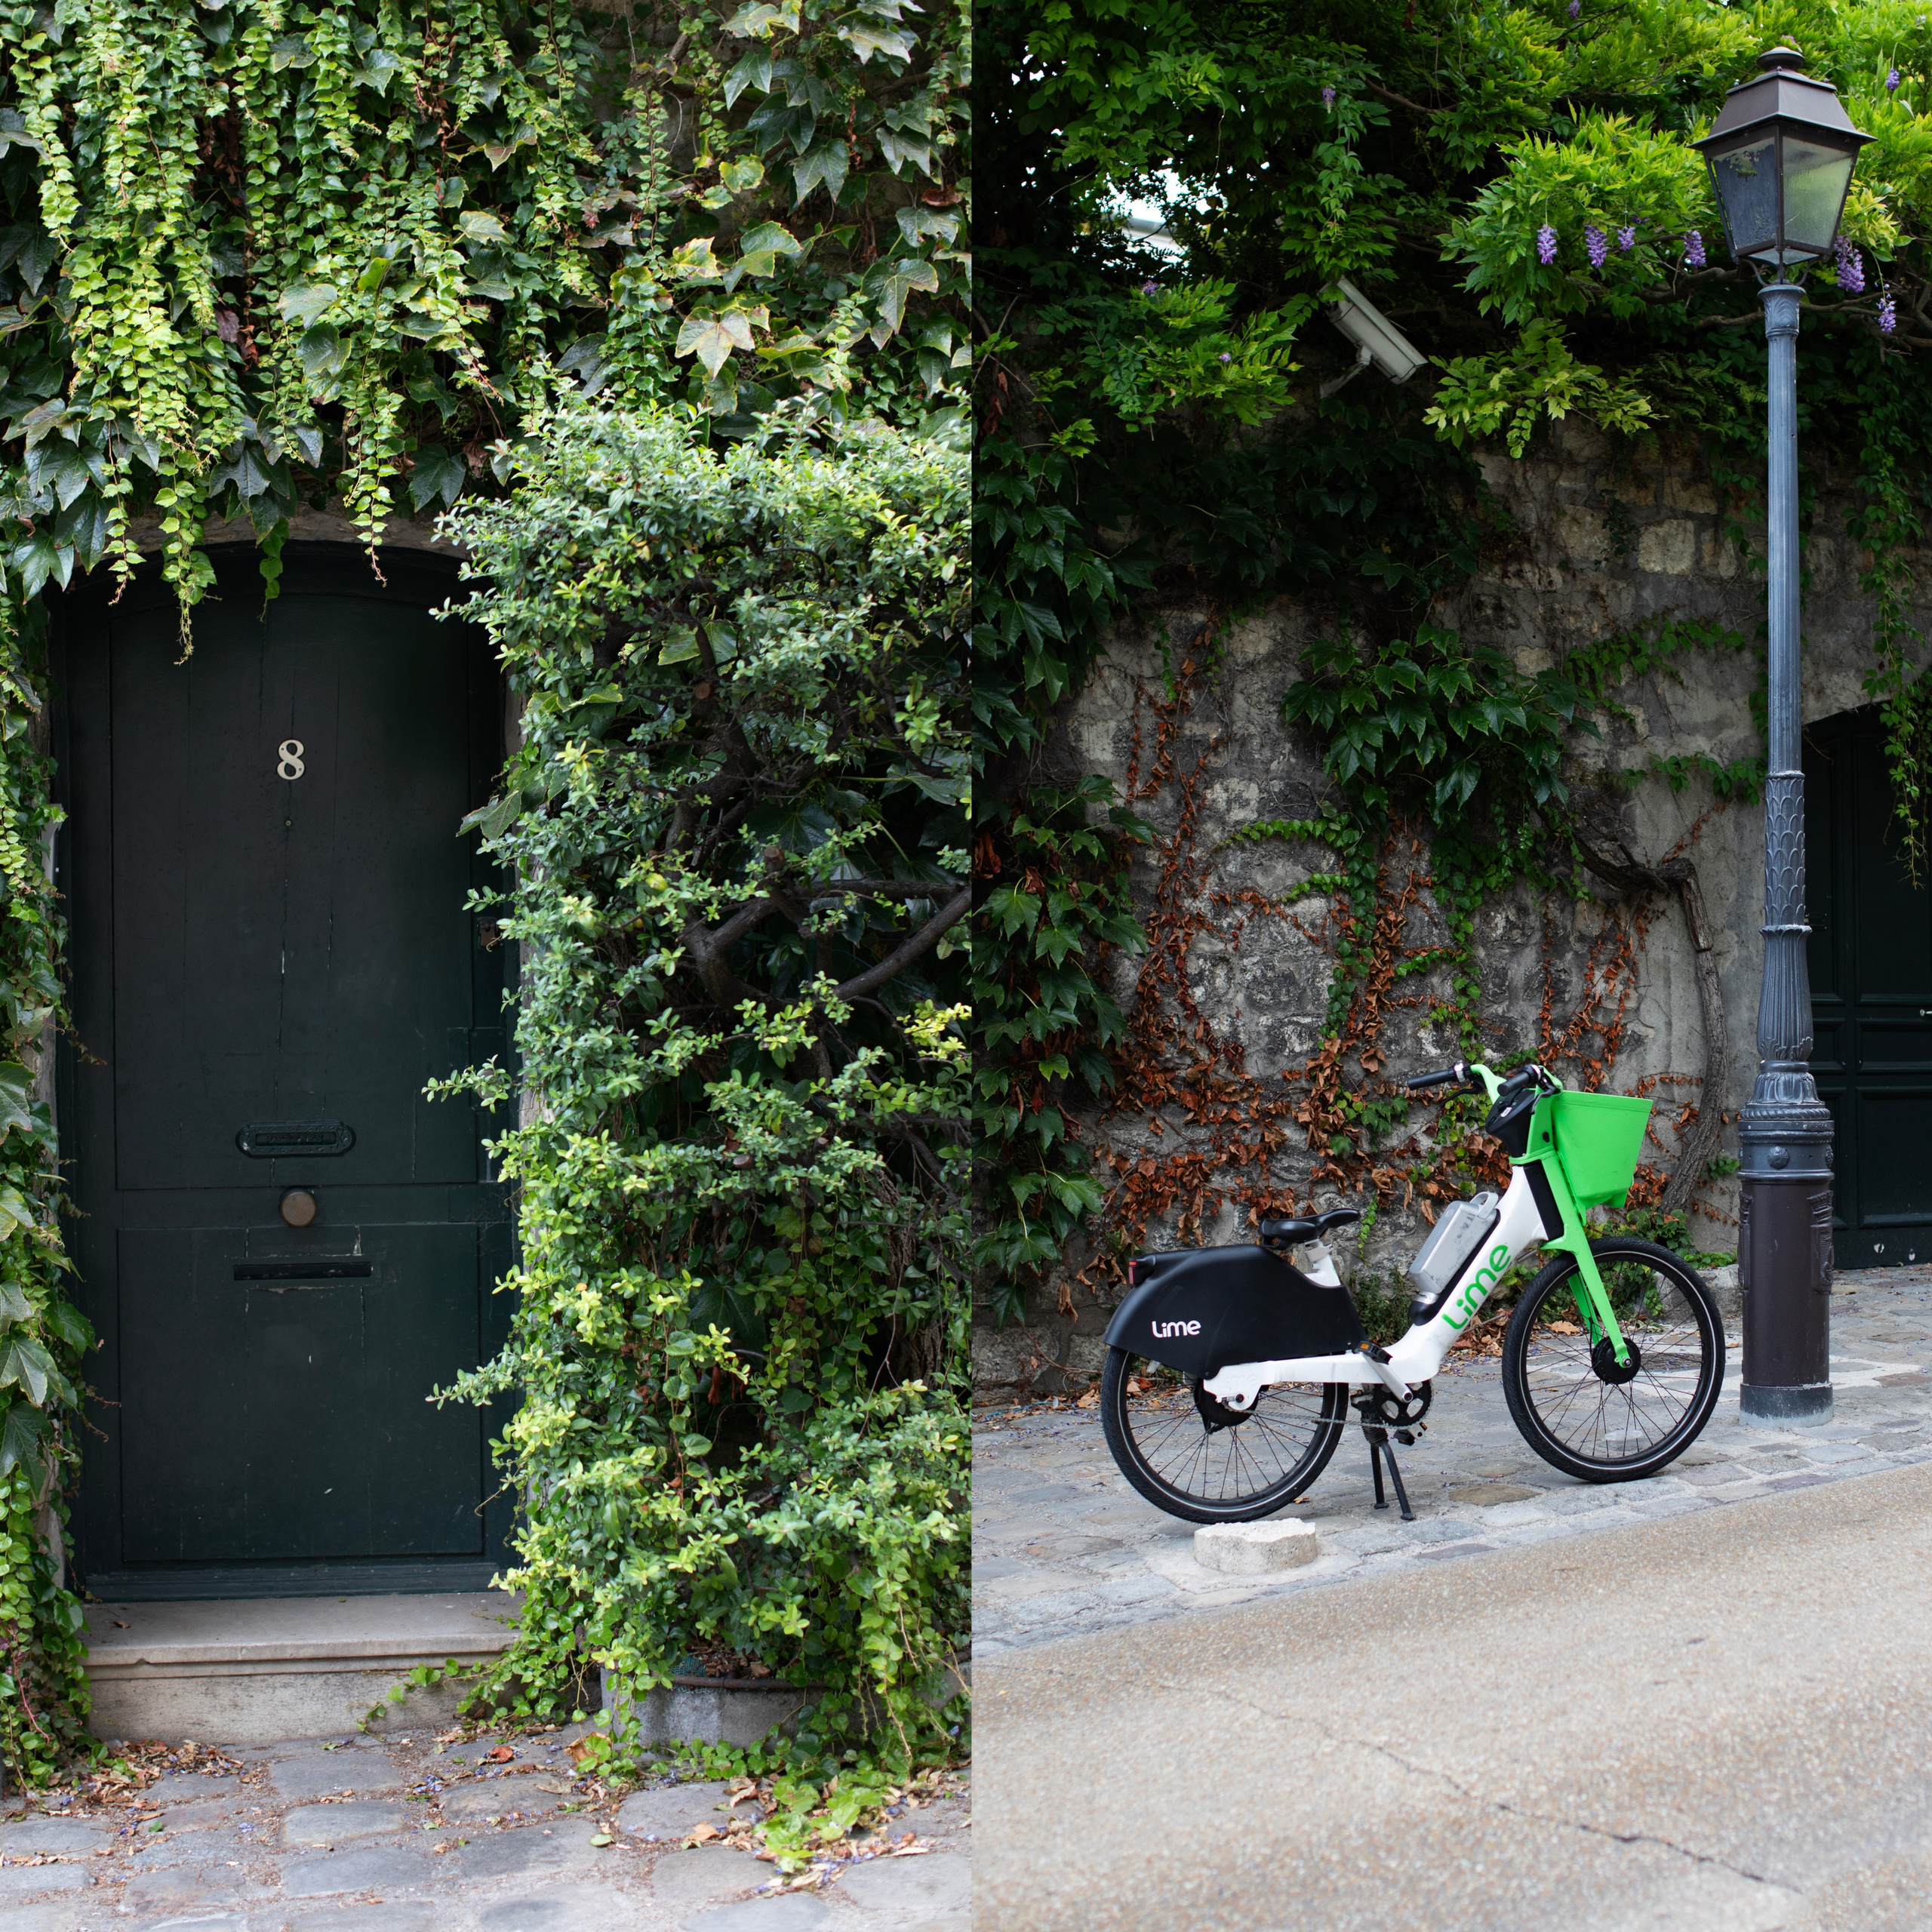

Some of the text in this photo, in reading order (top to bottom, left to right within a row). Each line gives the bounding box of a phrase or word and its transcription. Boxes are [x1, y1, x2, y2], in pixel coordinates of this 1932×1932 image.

[277, 739, 305, 780] 8
[1441, 1244, 1512, 1331] Lime
[1152, 1320, 1202, 1338] Lime
